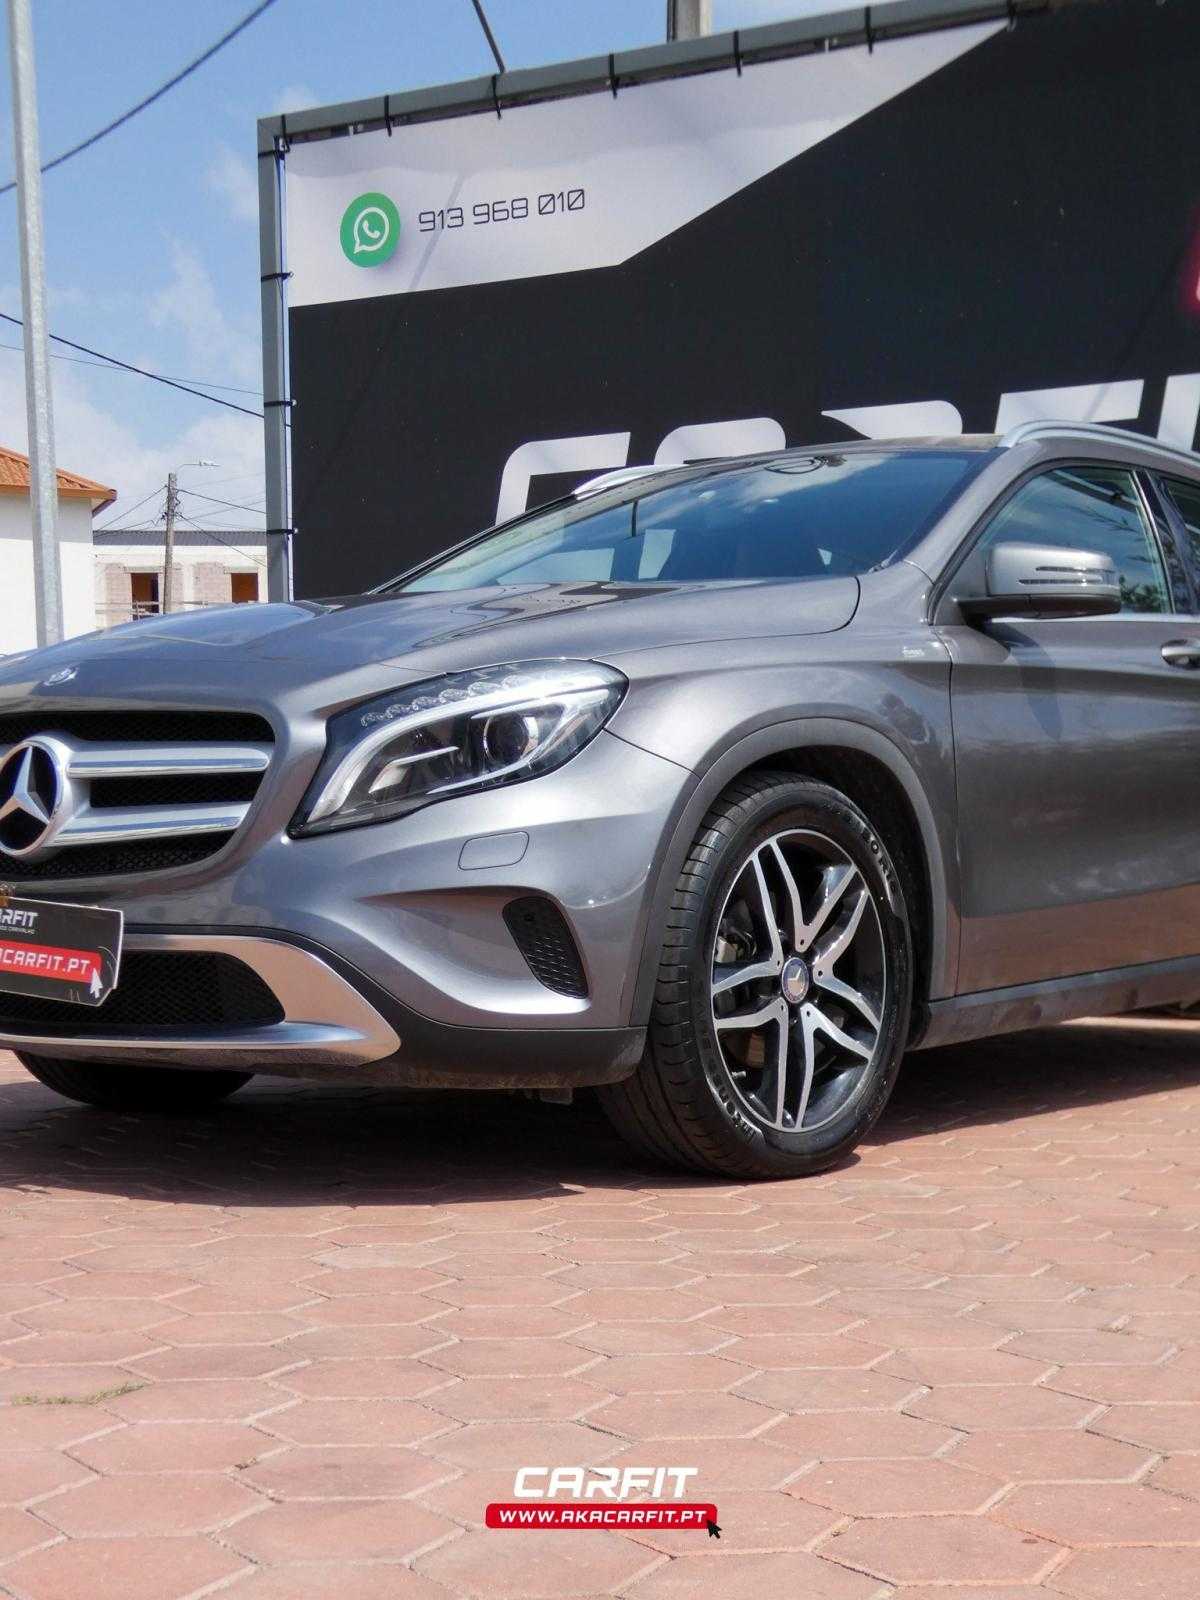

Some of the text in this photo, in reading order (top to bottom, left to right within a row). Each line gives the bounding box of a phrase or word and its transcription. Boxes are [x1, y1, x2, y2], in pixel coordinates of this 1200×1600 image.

[418, 188, 585, 232] 913 968 010
[0, 908, 39, 928] RFIT
